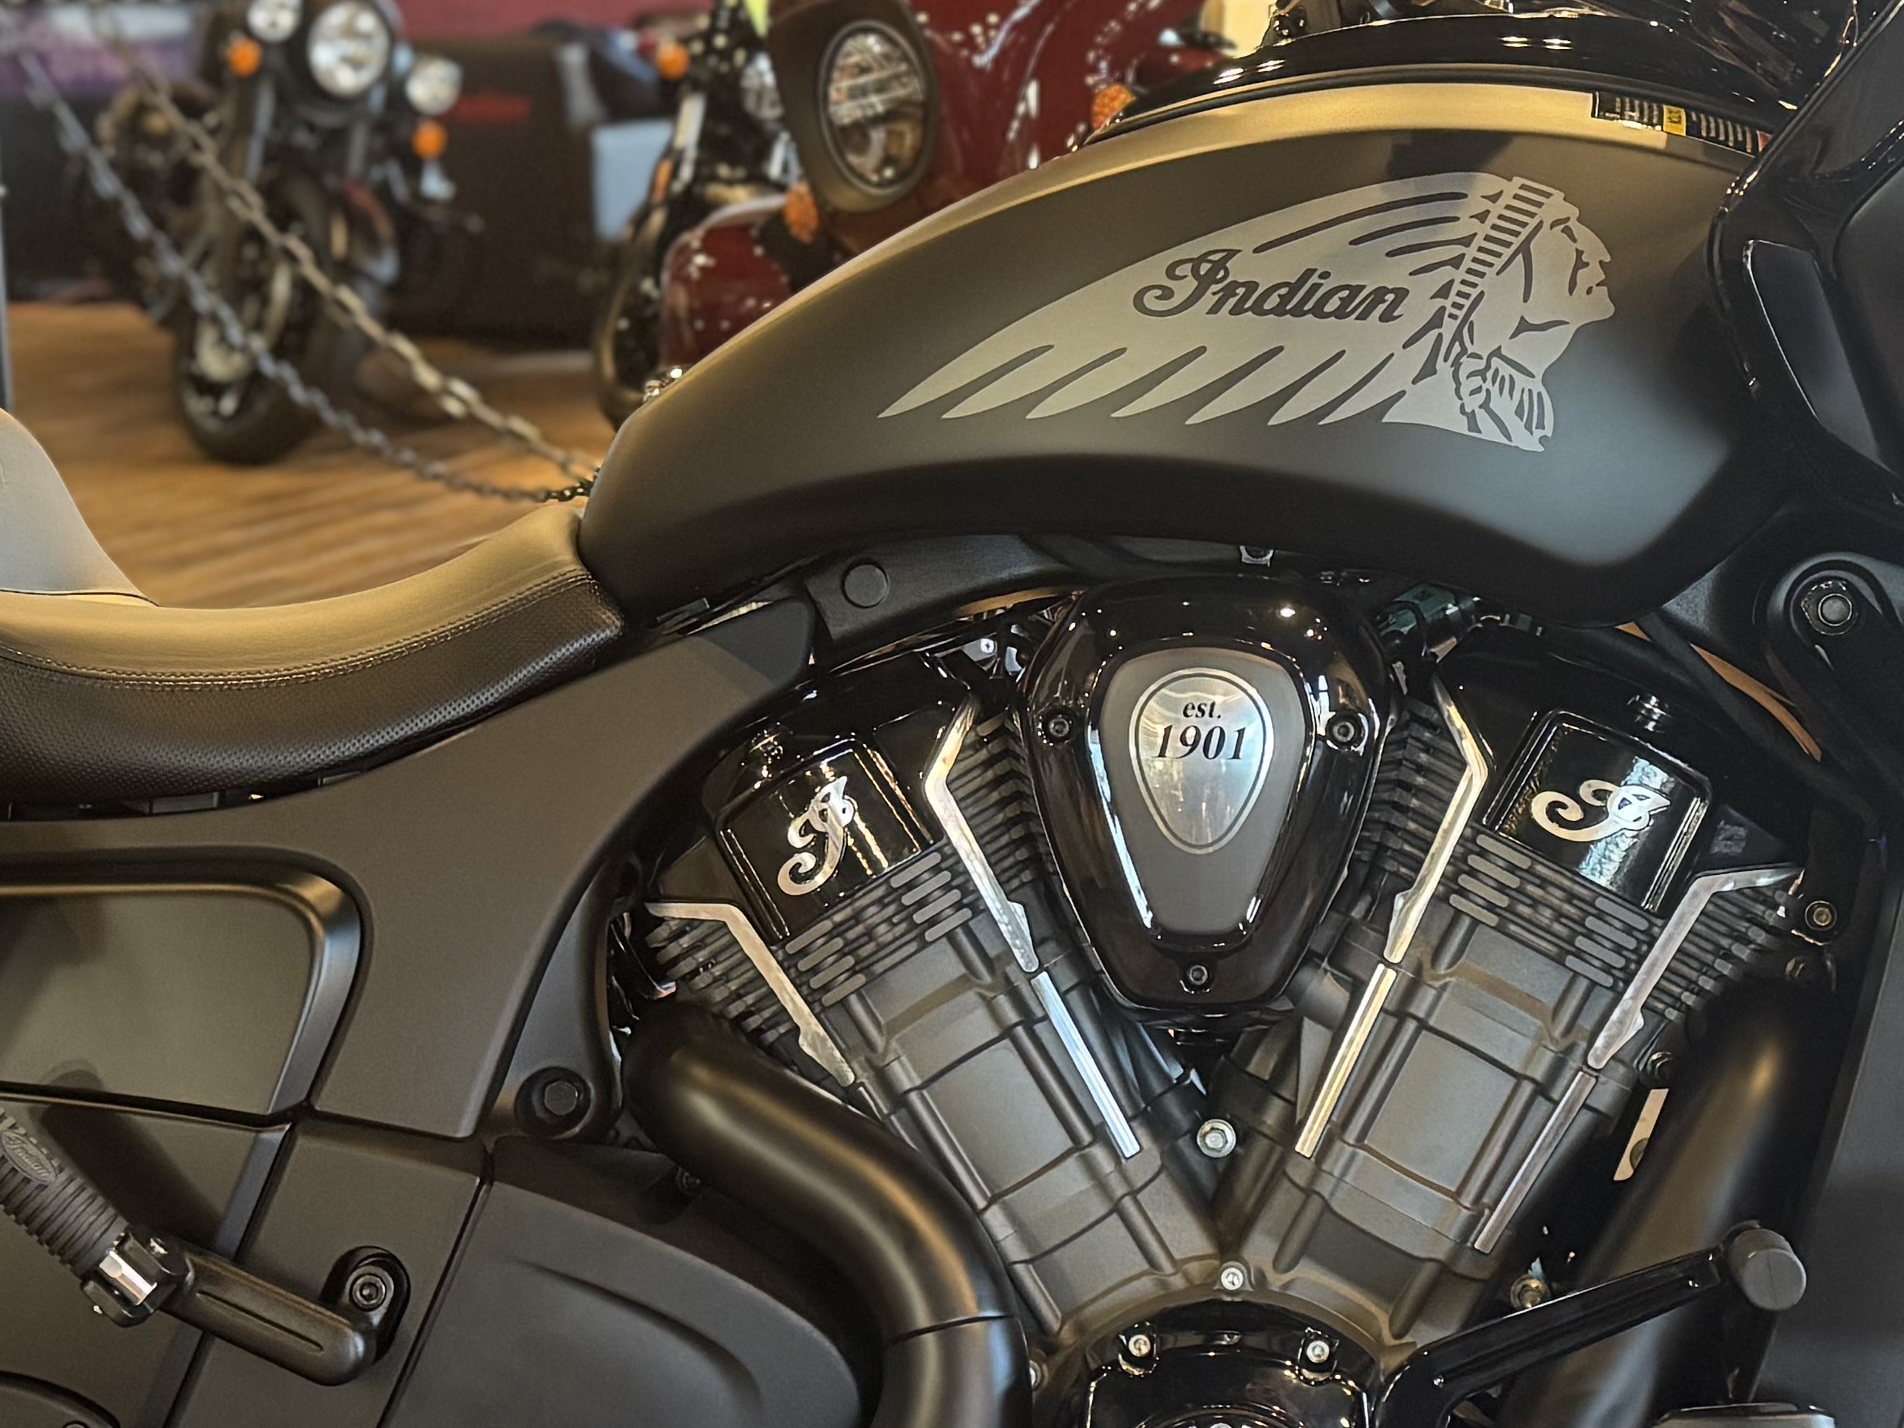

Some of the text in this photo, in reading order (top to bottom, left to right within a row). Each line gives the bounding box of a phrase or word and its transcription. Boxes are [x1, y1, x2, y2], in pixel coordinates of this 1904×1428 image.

[1133, 248, 1410, 323] Indian
[1182, 698, 1222, 720] est.
[1152, 723, 1247, 762] 1901
